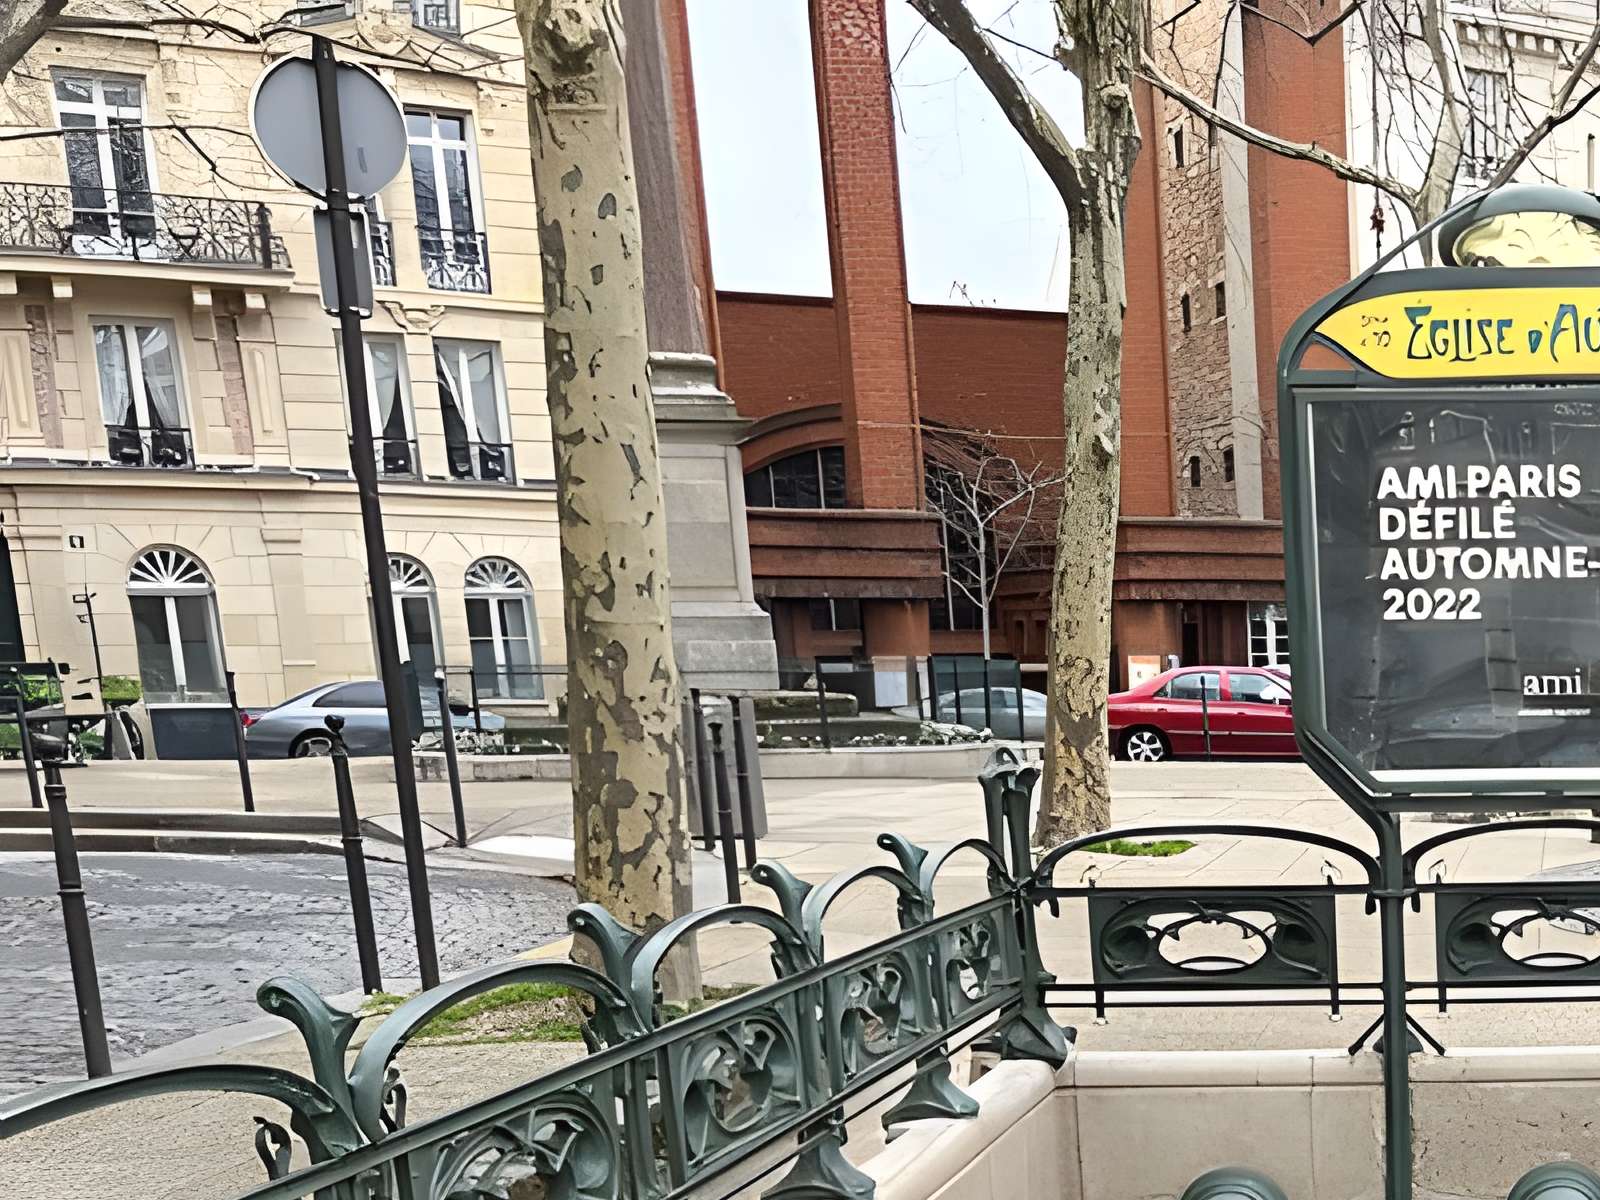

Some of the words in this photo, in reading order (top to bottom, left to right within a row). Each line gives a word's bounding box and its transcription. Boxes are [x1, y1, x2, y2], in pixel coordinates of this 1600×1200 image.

[1376, 464, 1457, 500] AMI
[1466, 462, 1582, 499] PARIS
[1378, 499, 1517, 541] DÉFILÉ
[1382, 587, 1483, 621] 2022
[1523, 667, 1582, 696] ami
